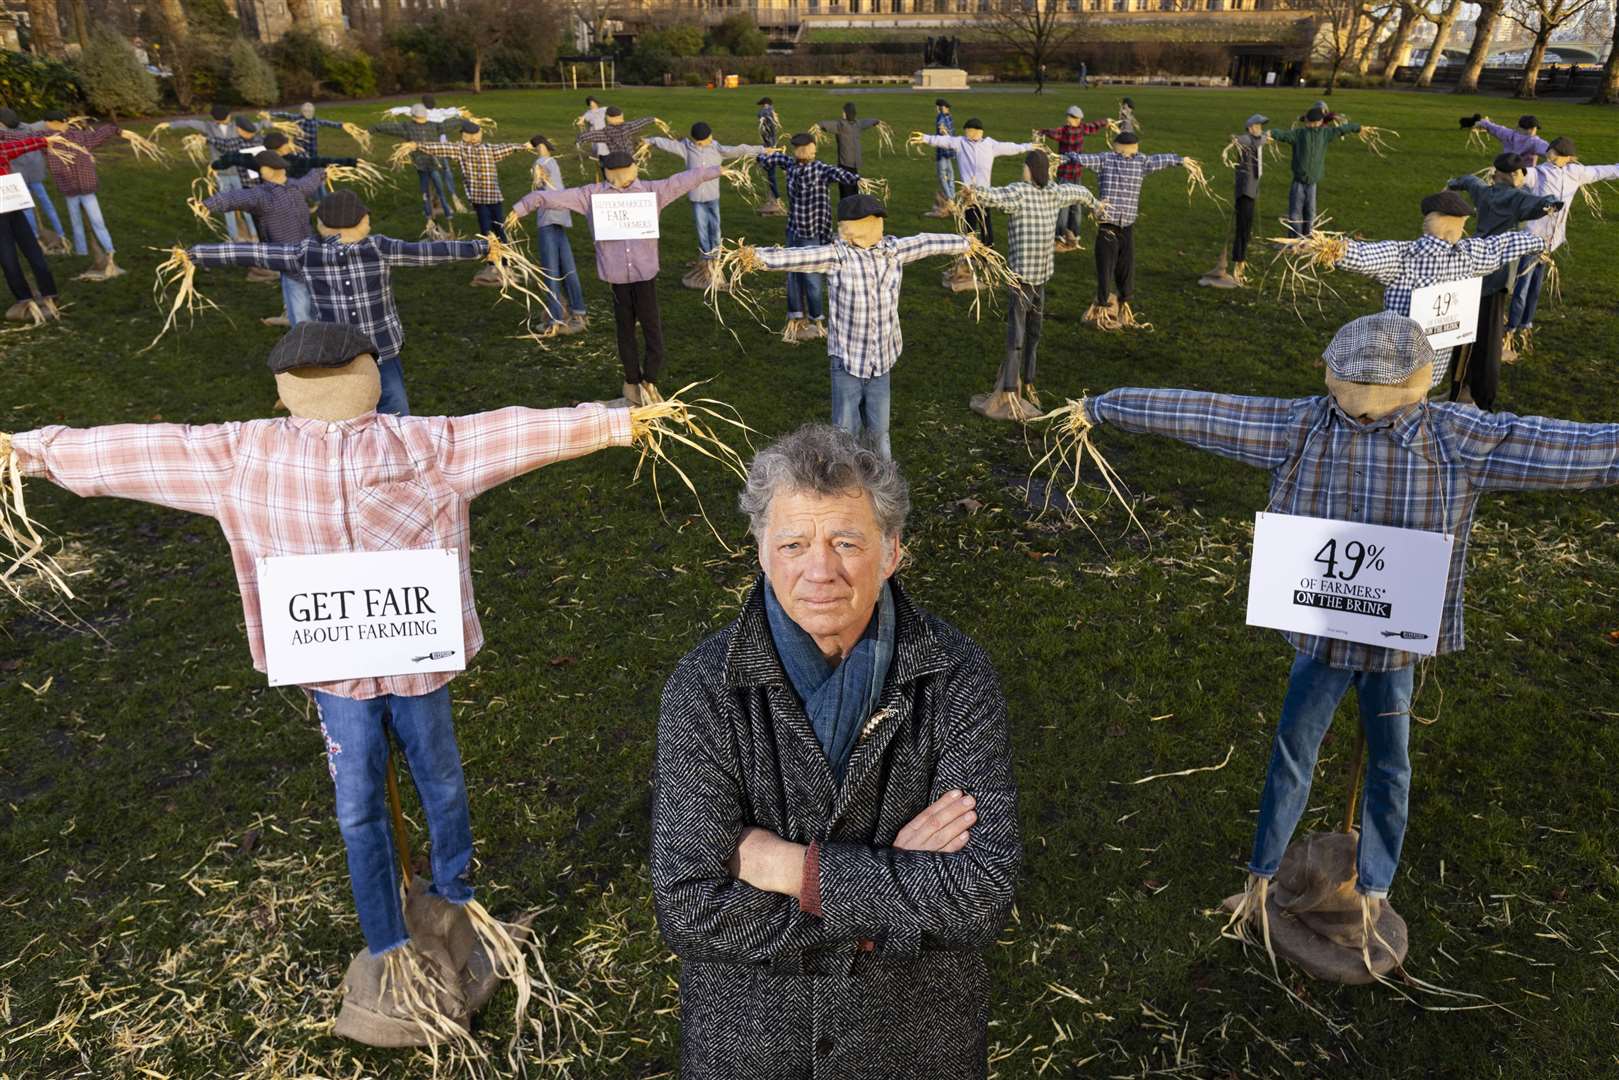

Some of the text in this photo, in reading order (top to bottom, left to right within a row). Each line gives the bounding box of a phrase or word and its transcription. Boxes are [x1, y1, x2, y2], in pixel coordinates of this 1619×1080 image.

[1314, 538, 1386, 581] 49%
[1300, 577, 1317, 590] OF
[289, 586, 436, 622] GET FAIR
[1296, 590, 1387, 617] ON THE BRINK
[292, 619, 437, 646] ABOUT FARMING
